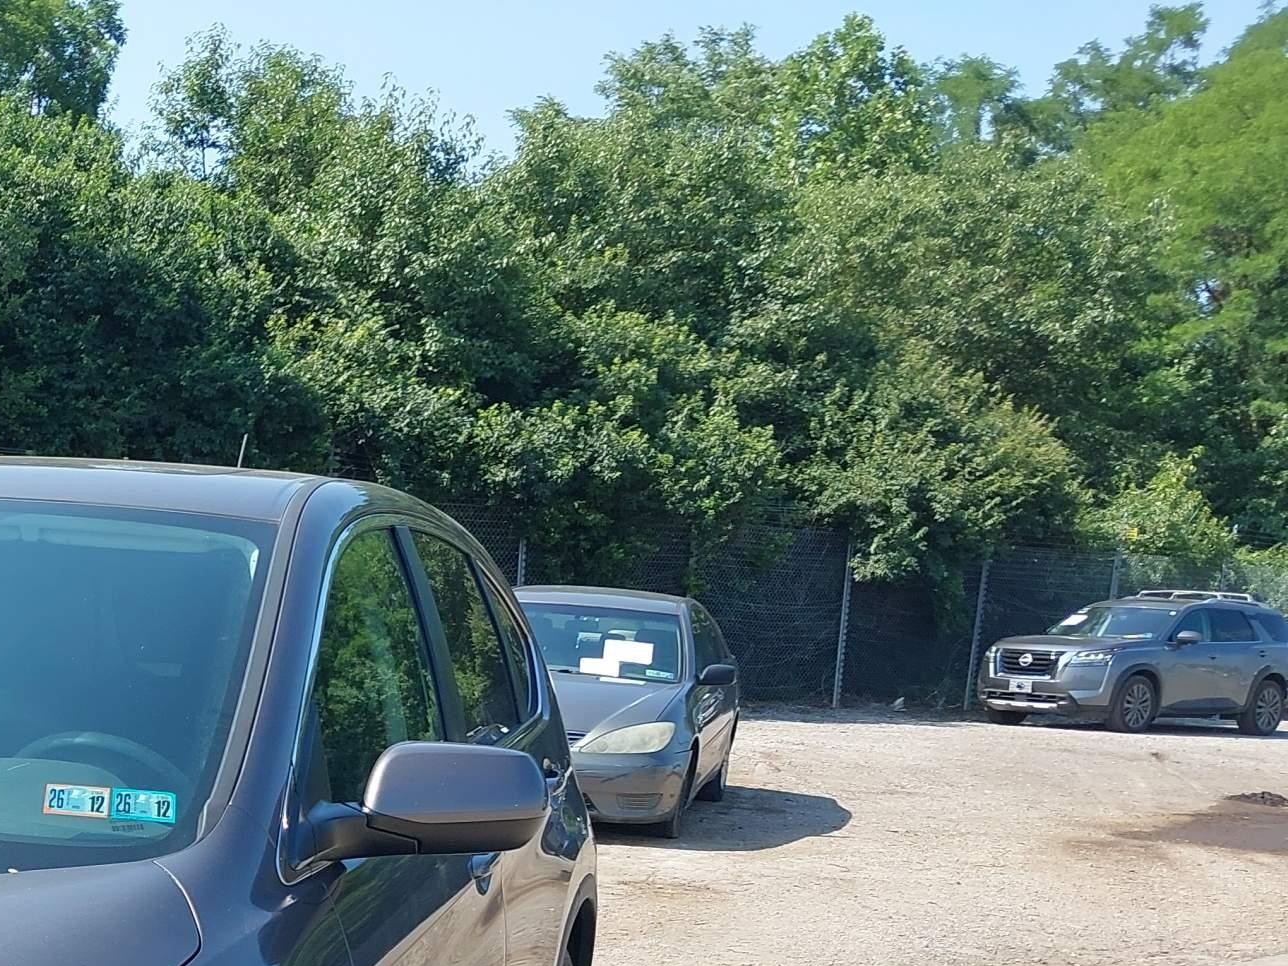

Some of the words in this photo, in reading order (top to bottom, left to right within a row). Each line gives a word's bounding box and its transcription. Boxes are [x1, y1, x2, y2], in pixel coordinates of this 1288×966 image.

[48, 788, 65, 809] 26
[88, 795, 105, 814] 12
[115, 792, 131, 814] 26
[154, 799, 171, 818] 12
